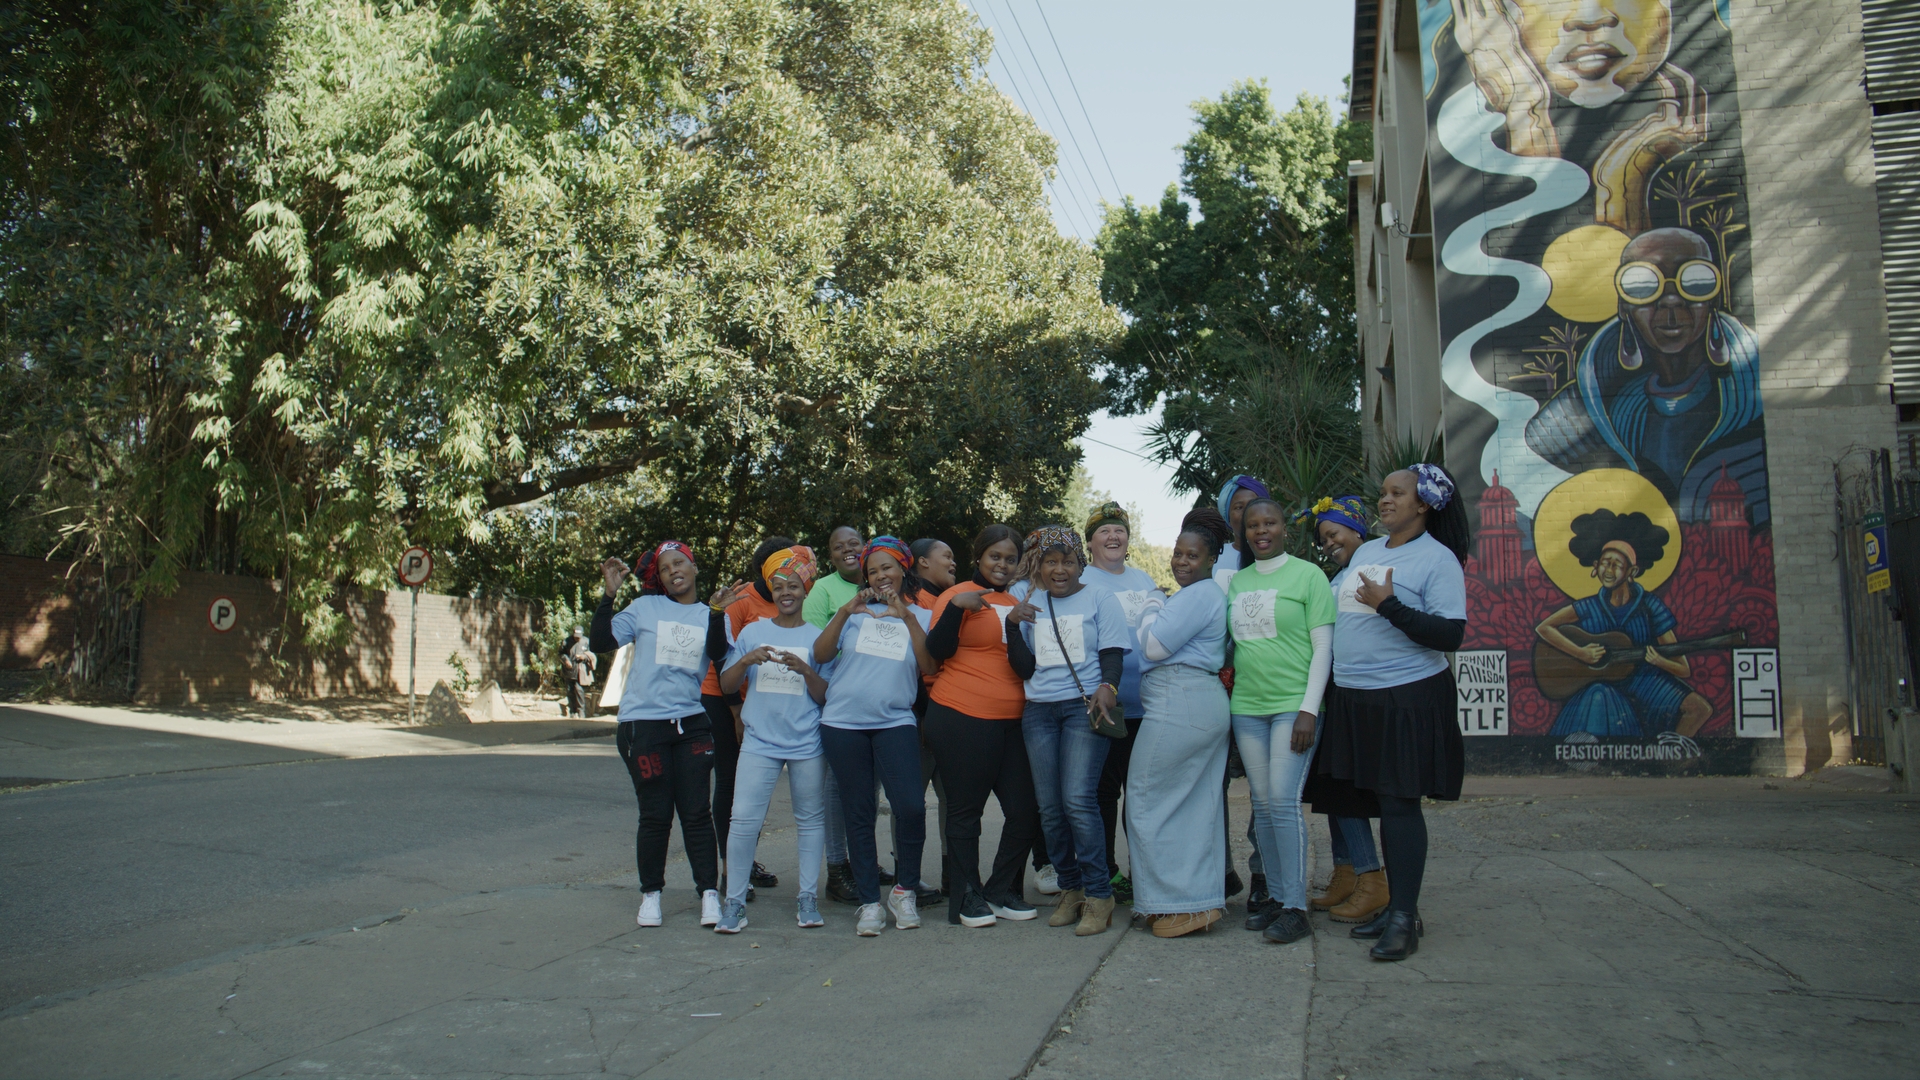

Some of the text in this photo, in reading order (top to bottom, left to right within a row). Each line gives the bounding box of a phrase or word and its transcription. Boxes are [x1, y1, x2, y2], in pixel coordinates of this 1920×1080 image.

[217, 606, 230, 625] P
[1459, 654, 1505, 674] JOHNNY
[1555, 744, 1682, 760] FEASTOFTHECLOWNS
